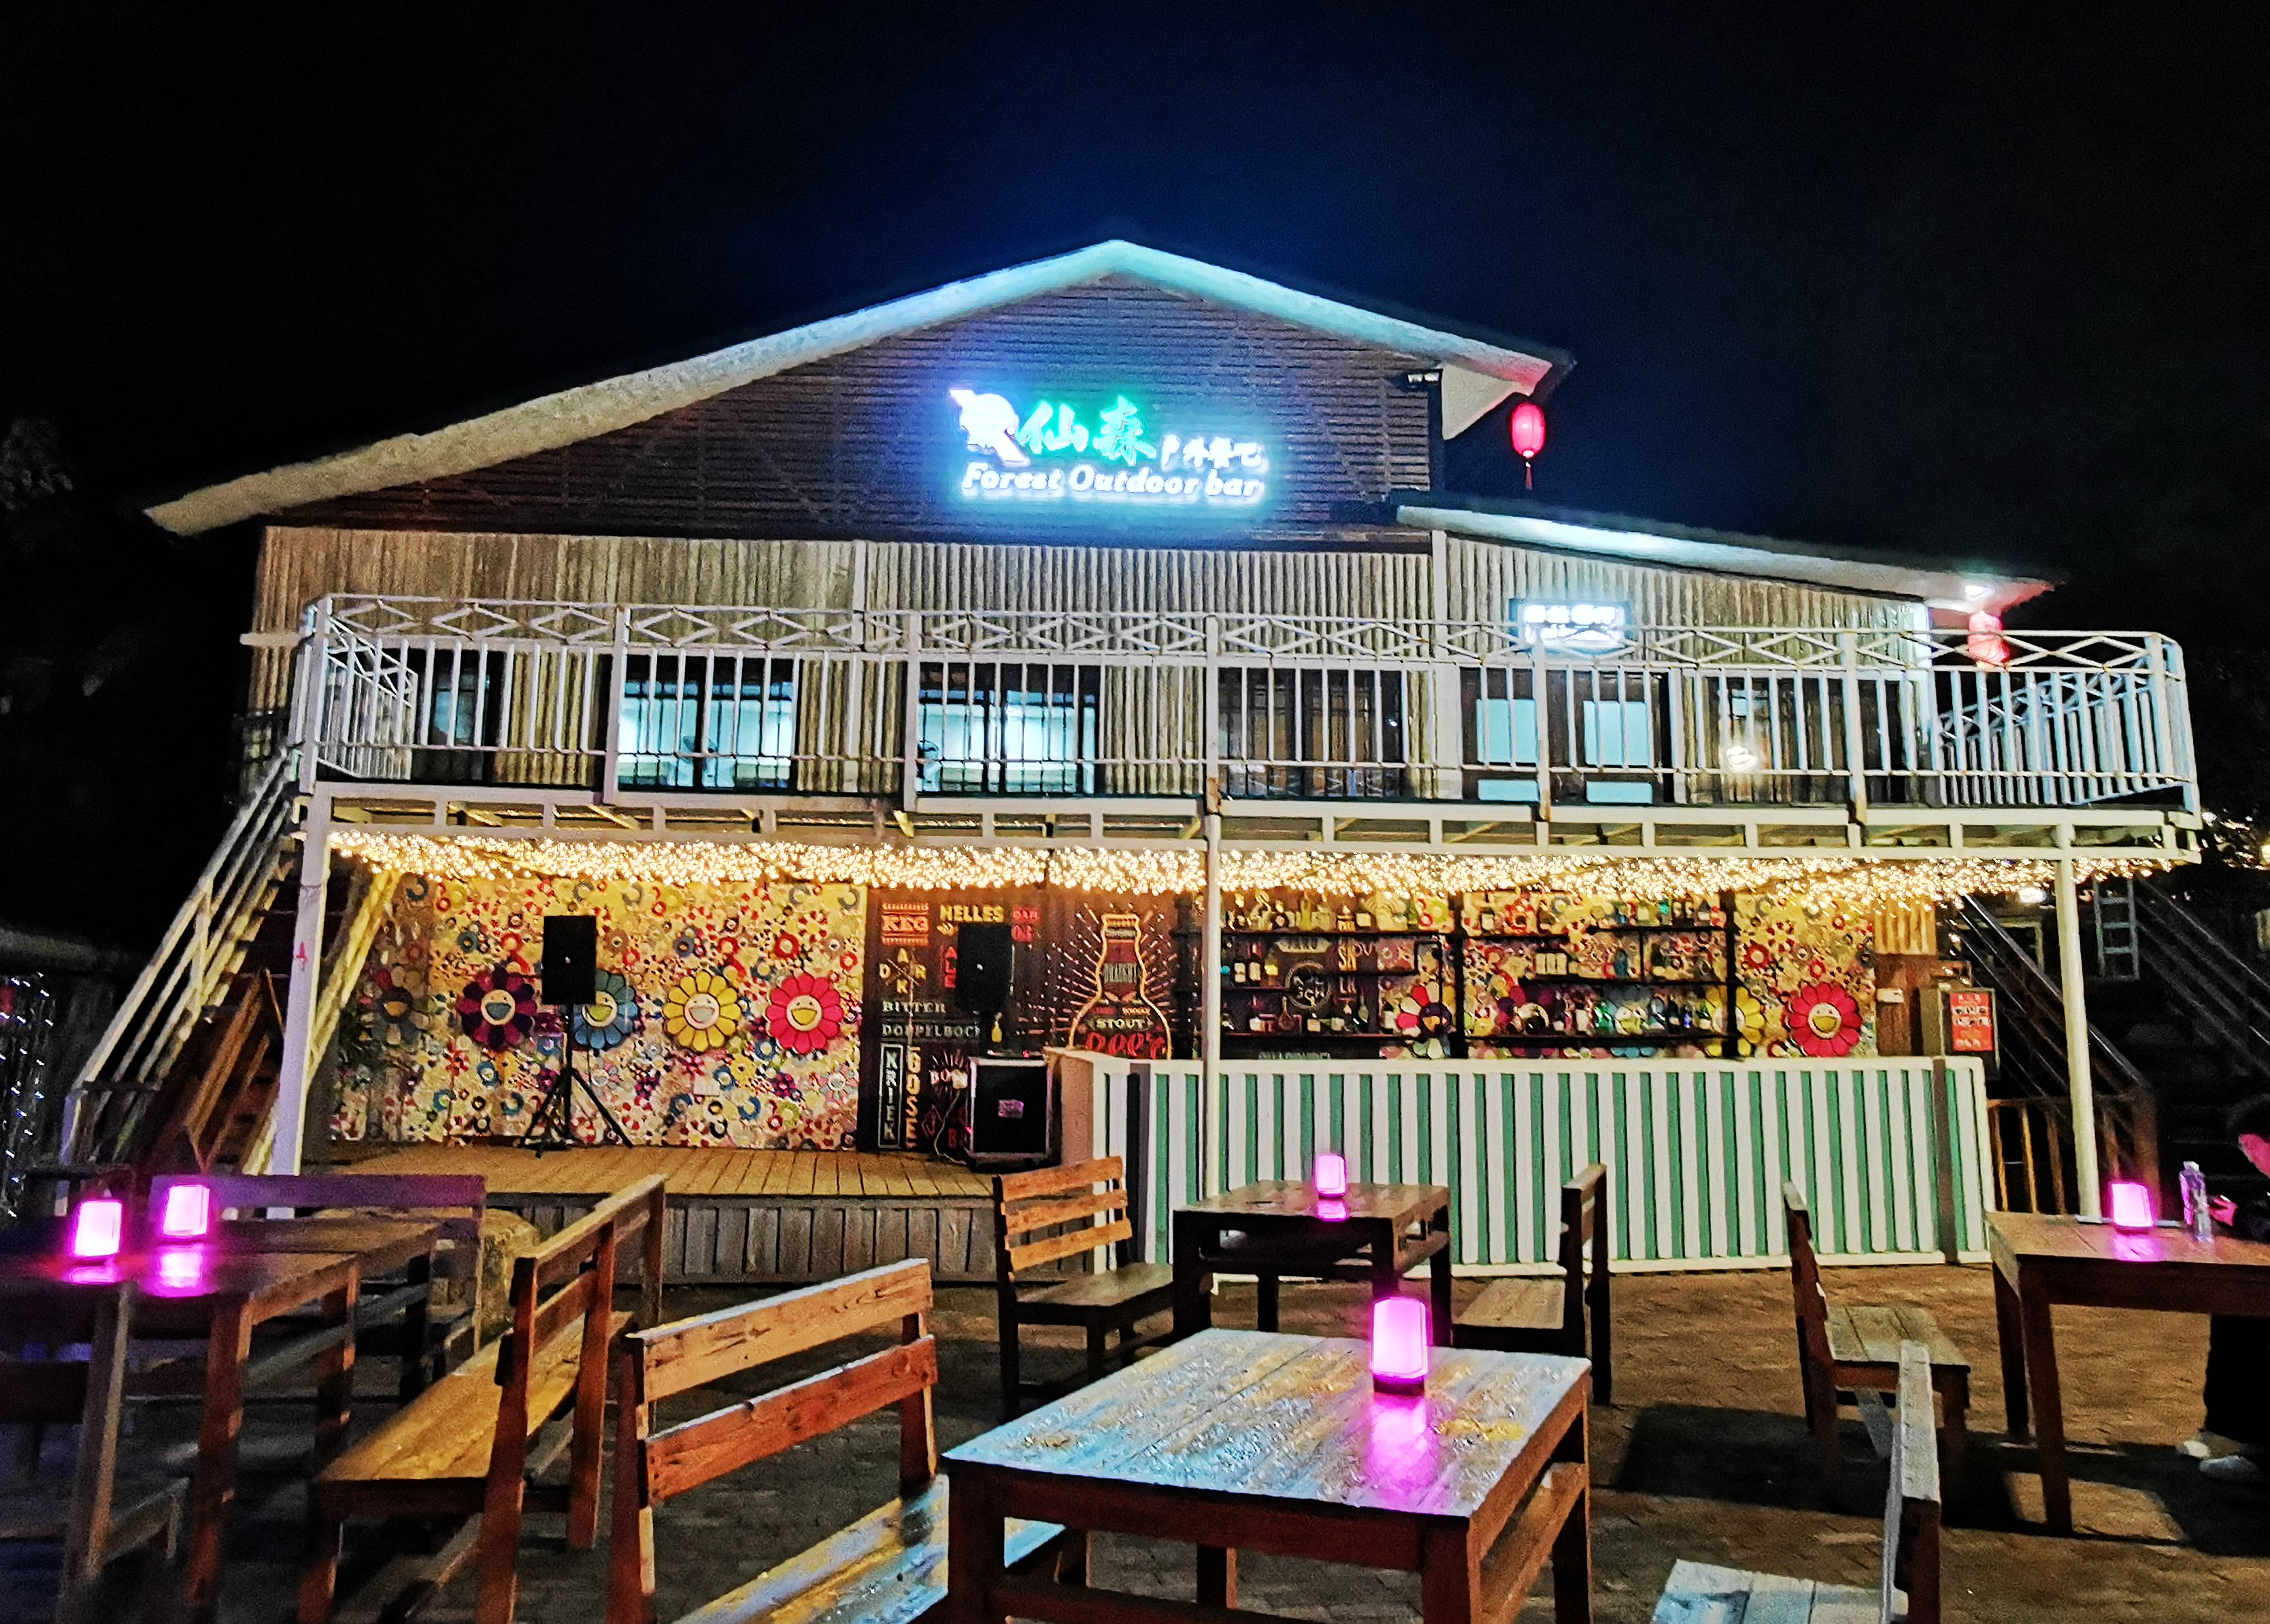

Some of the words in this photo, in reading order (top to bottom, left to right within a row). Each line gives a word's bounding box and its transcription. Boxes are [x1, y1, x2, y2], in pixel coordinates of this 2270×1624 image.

[961, 462, 1063, 490] Forest
[1068, 464, 1200, 495] Outdoor
[1204, 469, 1262, 496] bar
[940, 904, 1005, 922] HELLES
[1096, 1018, 1146, 1030] STOUT
